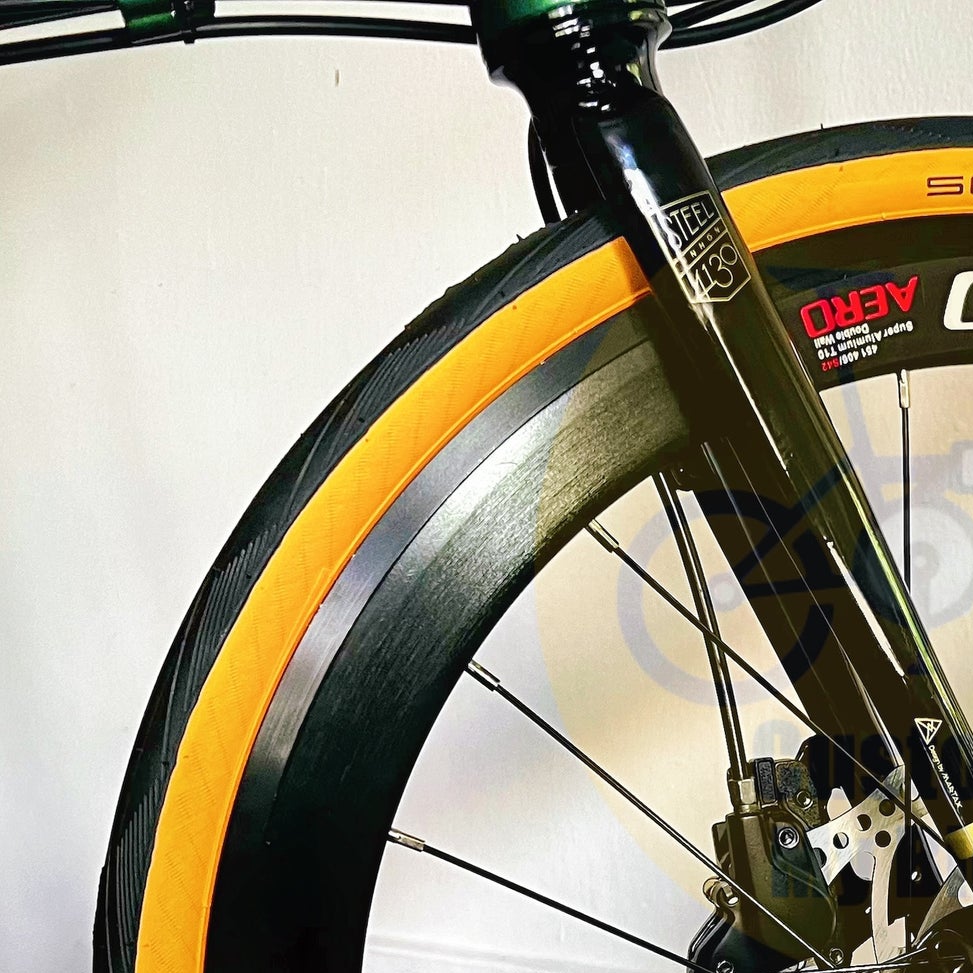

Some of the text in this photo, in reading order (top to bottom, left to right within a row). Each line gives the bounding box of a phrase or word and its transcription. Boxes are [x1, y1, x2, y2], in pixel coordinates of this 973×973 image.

[663, 201, 715, 250] STEEL
[800, 276, 918, 338] AERO
[813, 322, 870, 349] Double Wall
[883, 320, 914, 338] Super
[817, 346, 838, 360] T10
[861, 344, 878, 358] 451
